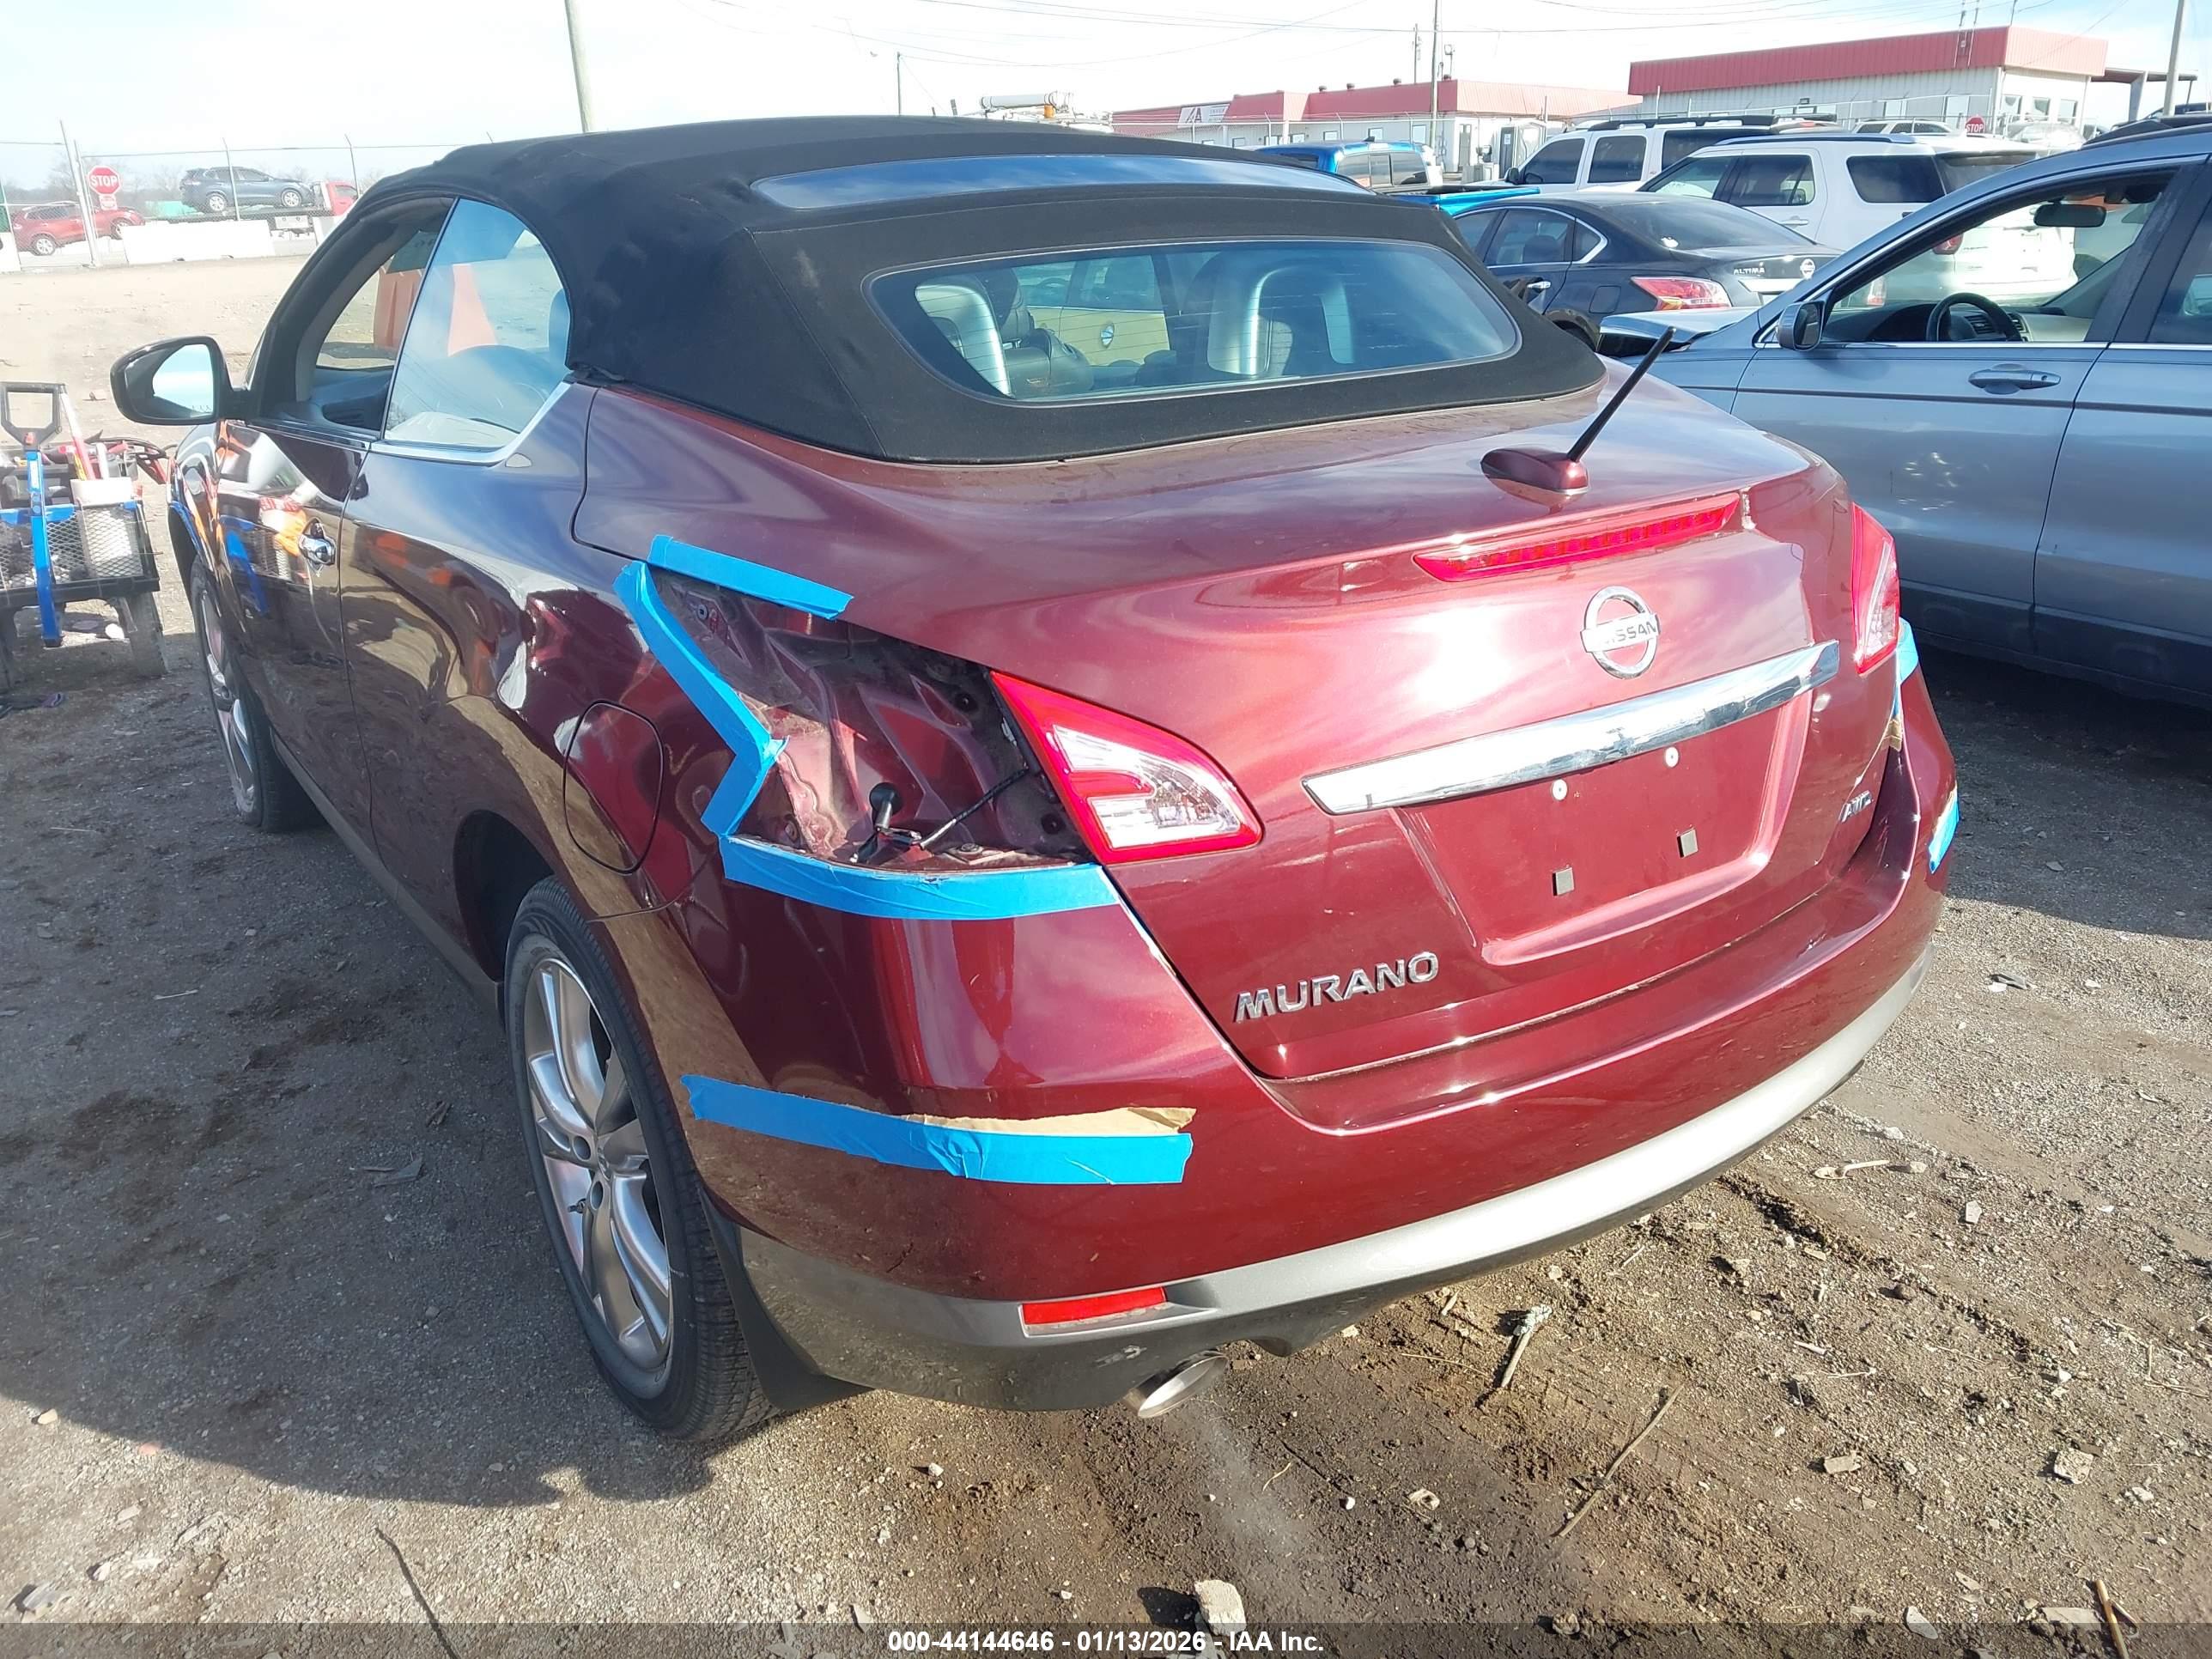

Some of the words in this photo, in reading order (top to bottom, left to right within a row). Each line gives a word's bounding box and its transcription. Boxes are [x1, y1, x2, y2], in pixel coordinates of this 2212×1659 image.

[1966, 123, 1984, 133] STOP
[90, 174, 118, 186] STOP
[1734, 267, 1765, 276] ALTIMA
[1233, 951, 1439, 1024] MURANO
